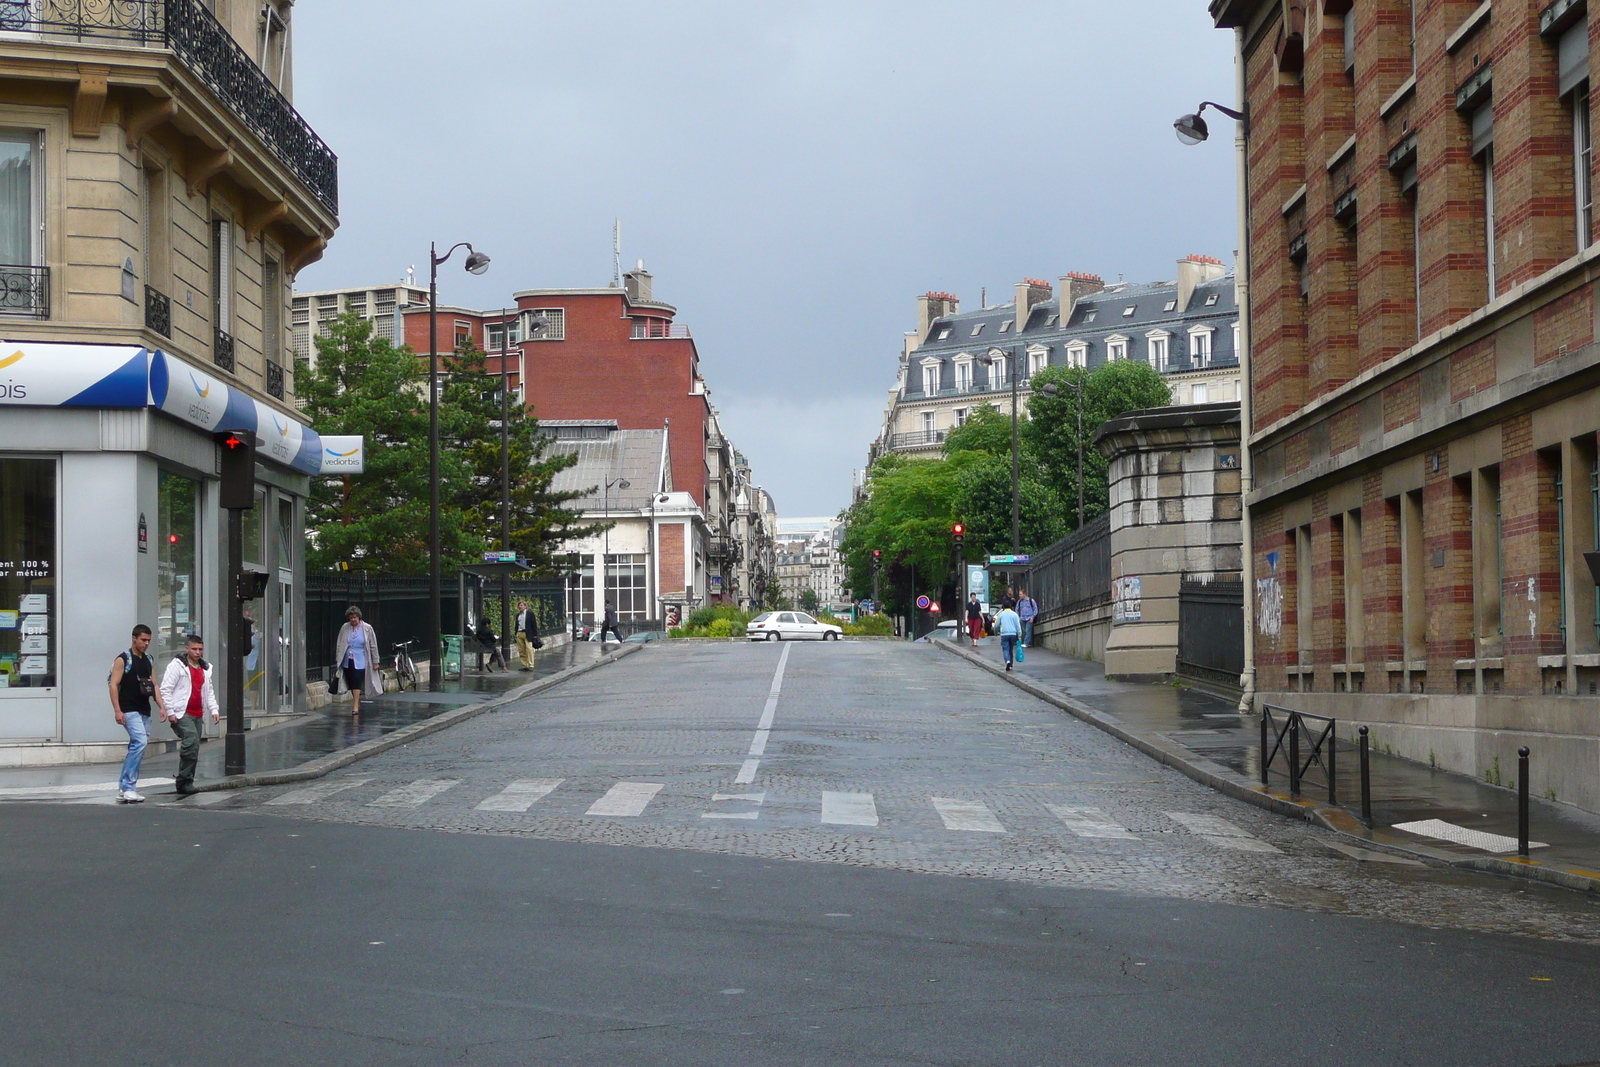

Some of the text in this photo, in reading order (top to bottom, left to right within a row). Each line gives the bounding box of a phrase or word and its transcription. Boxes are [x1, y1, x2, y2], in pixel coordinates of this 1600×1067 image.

[324, 458, 360, 466] vediorbis
[21, 560, 38, 568] 100
[41, 560, 49, 568] %
[16, 569, 48, 577] métier
[27, 626, 45, 635] BTP
